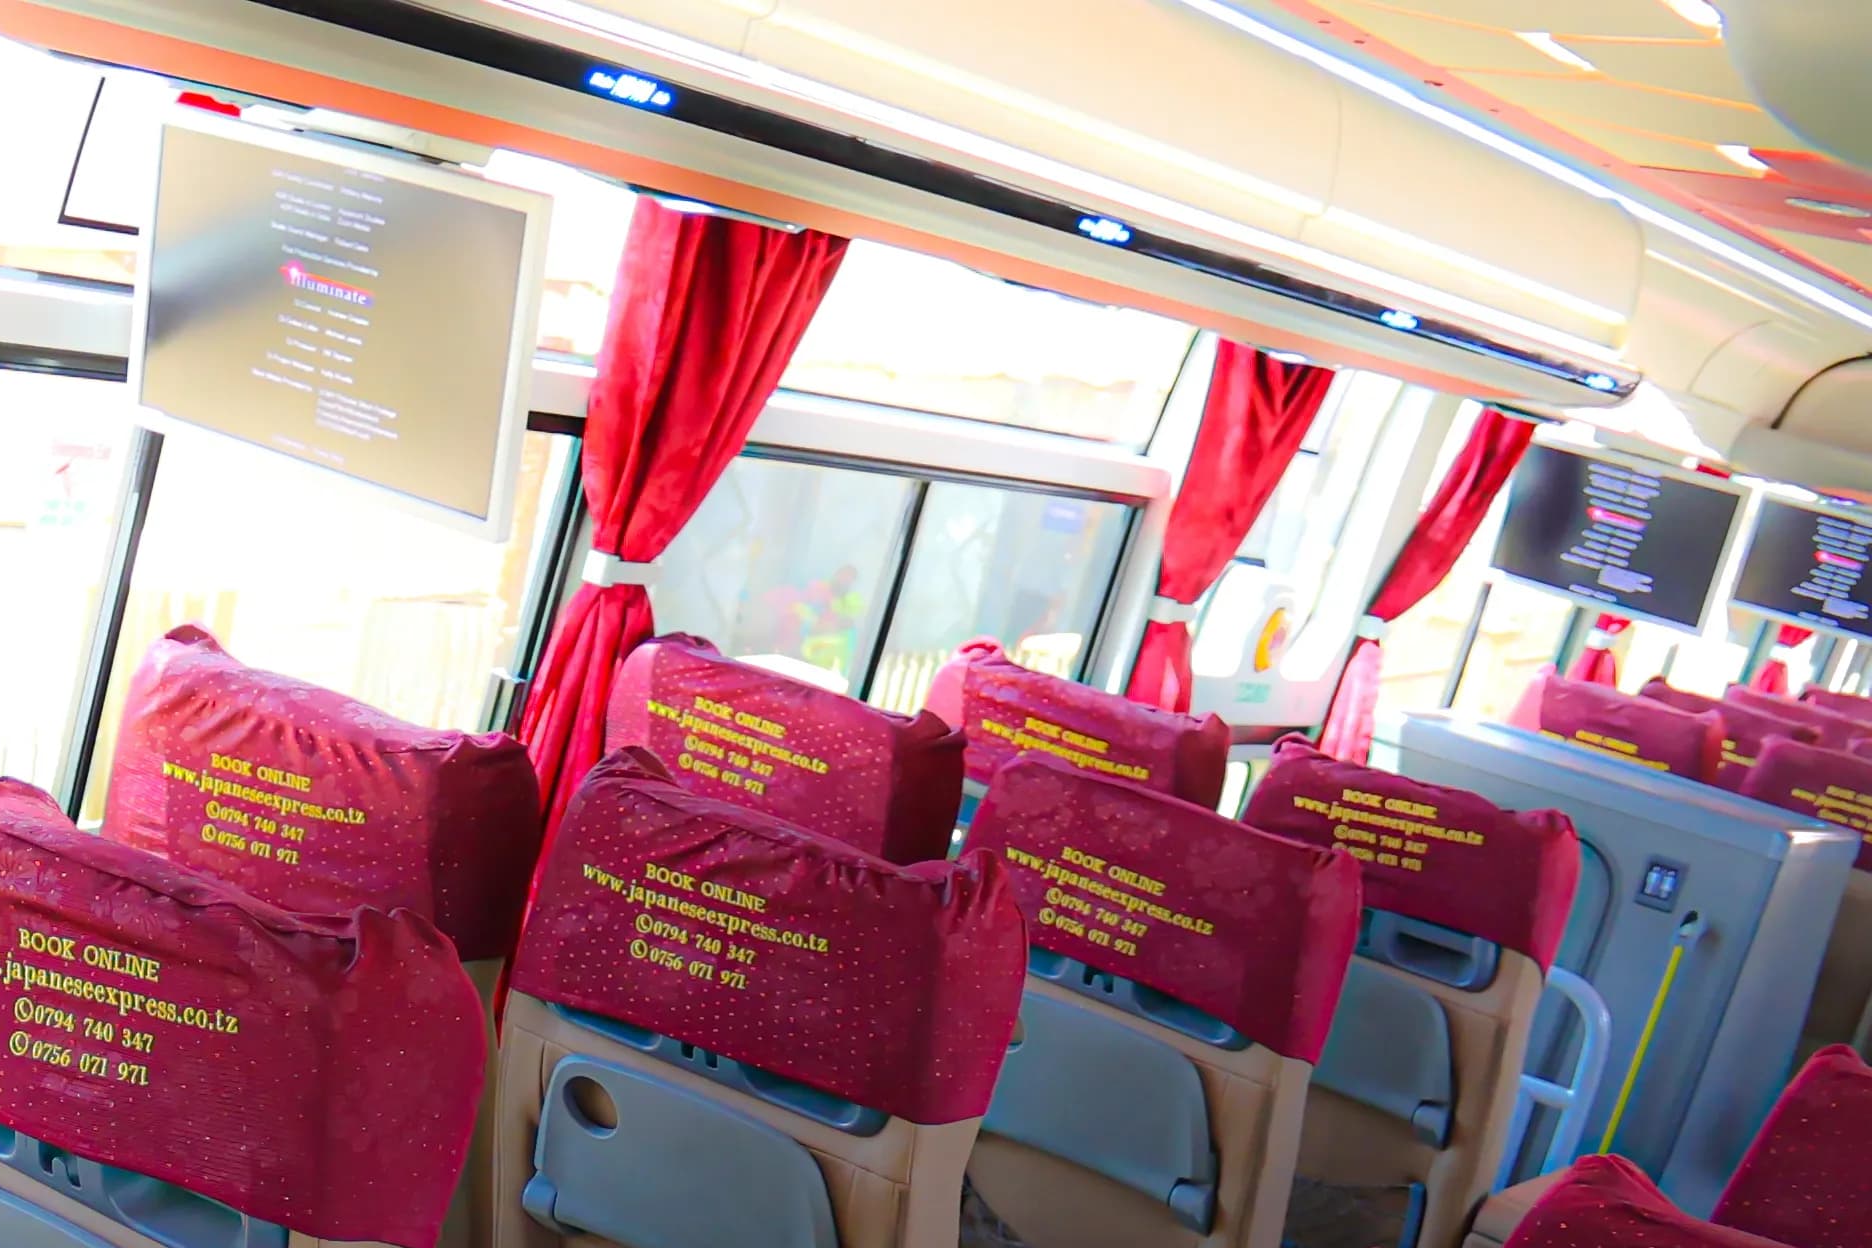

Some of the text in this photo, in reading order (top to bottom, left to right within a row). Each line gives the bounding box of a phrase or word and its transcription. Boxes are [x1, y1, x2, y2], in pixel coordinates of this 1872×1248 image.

[694, 696, 787, 739] BOOK ONLINE
[162, 762, 366, 824] www.japaneseexpress.co.tz
[211, 753, 311, 792] BOOK ONLINE
[220, 807, 304, 842] 0794 740 347
[218, 831, 299, 864] 0756 071 971
[645, 863, 766, 914] BOOK ONLINE
[1006, 846, 1214, 935] www.japaneseexpress.co.tz
[1061, 846, 1167, 897] BOOK ONLINE
[583, 863, 829, 953] www.japaneseexpress.co.tz
[1096, 907, 1121, 927] 740
[18, 928, 160, 982] BOOK ONLINE
[653, 921, 756, 965] 0794 740 347
[1087, 928, 1111, 947] 071
[1113, 938, 1137, 957] 971
[649, 947, 746, 990] 0756 071 971
[35, 1005, 154, 1054] 0794 740 347
[32, 1040, 149, 1087] 0756 071 971
